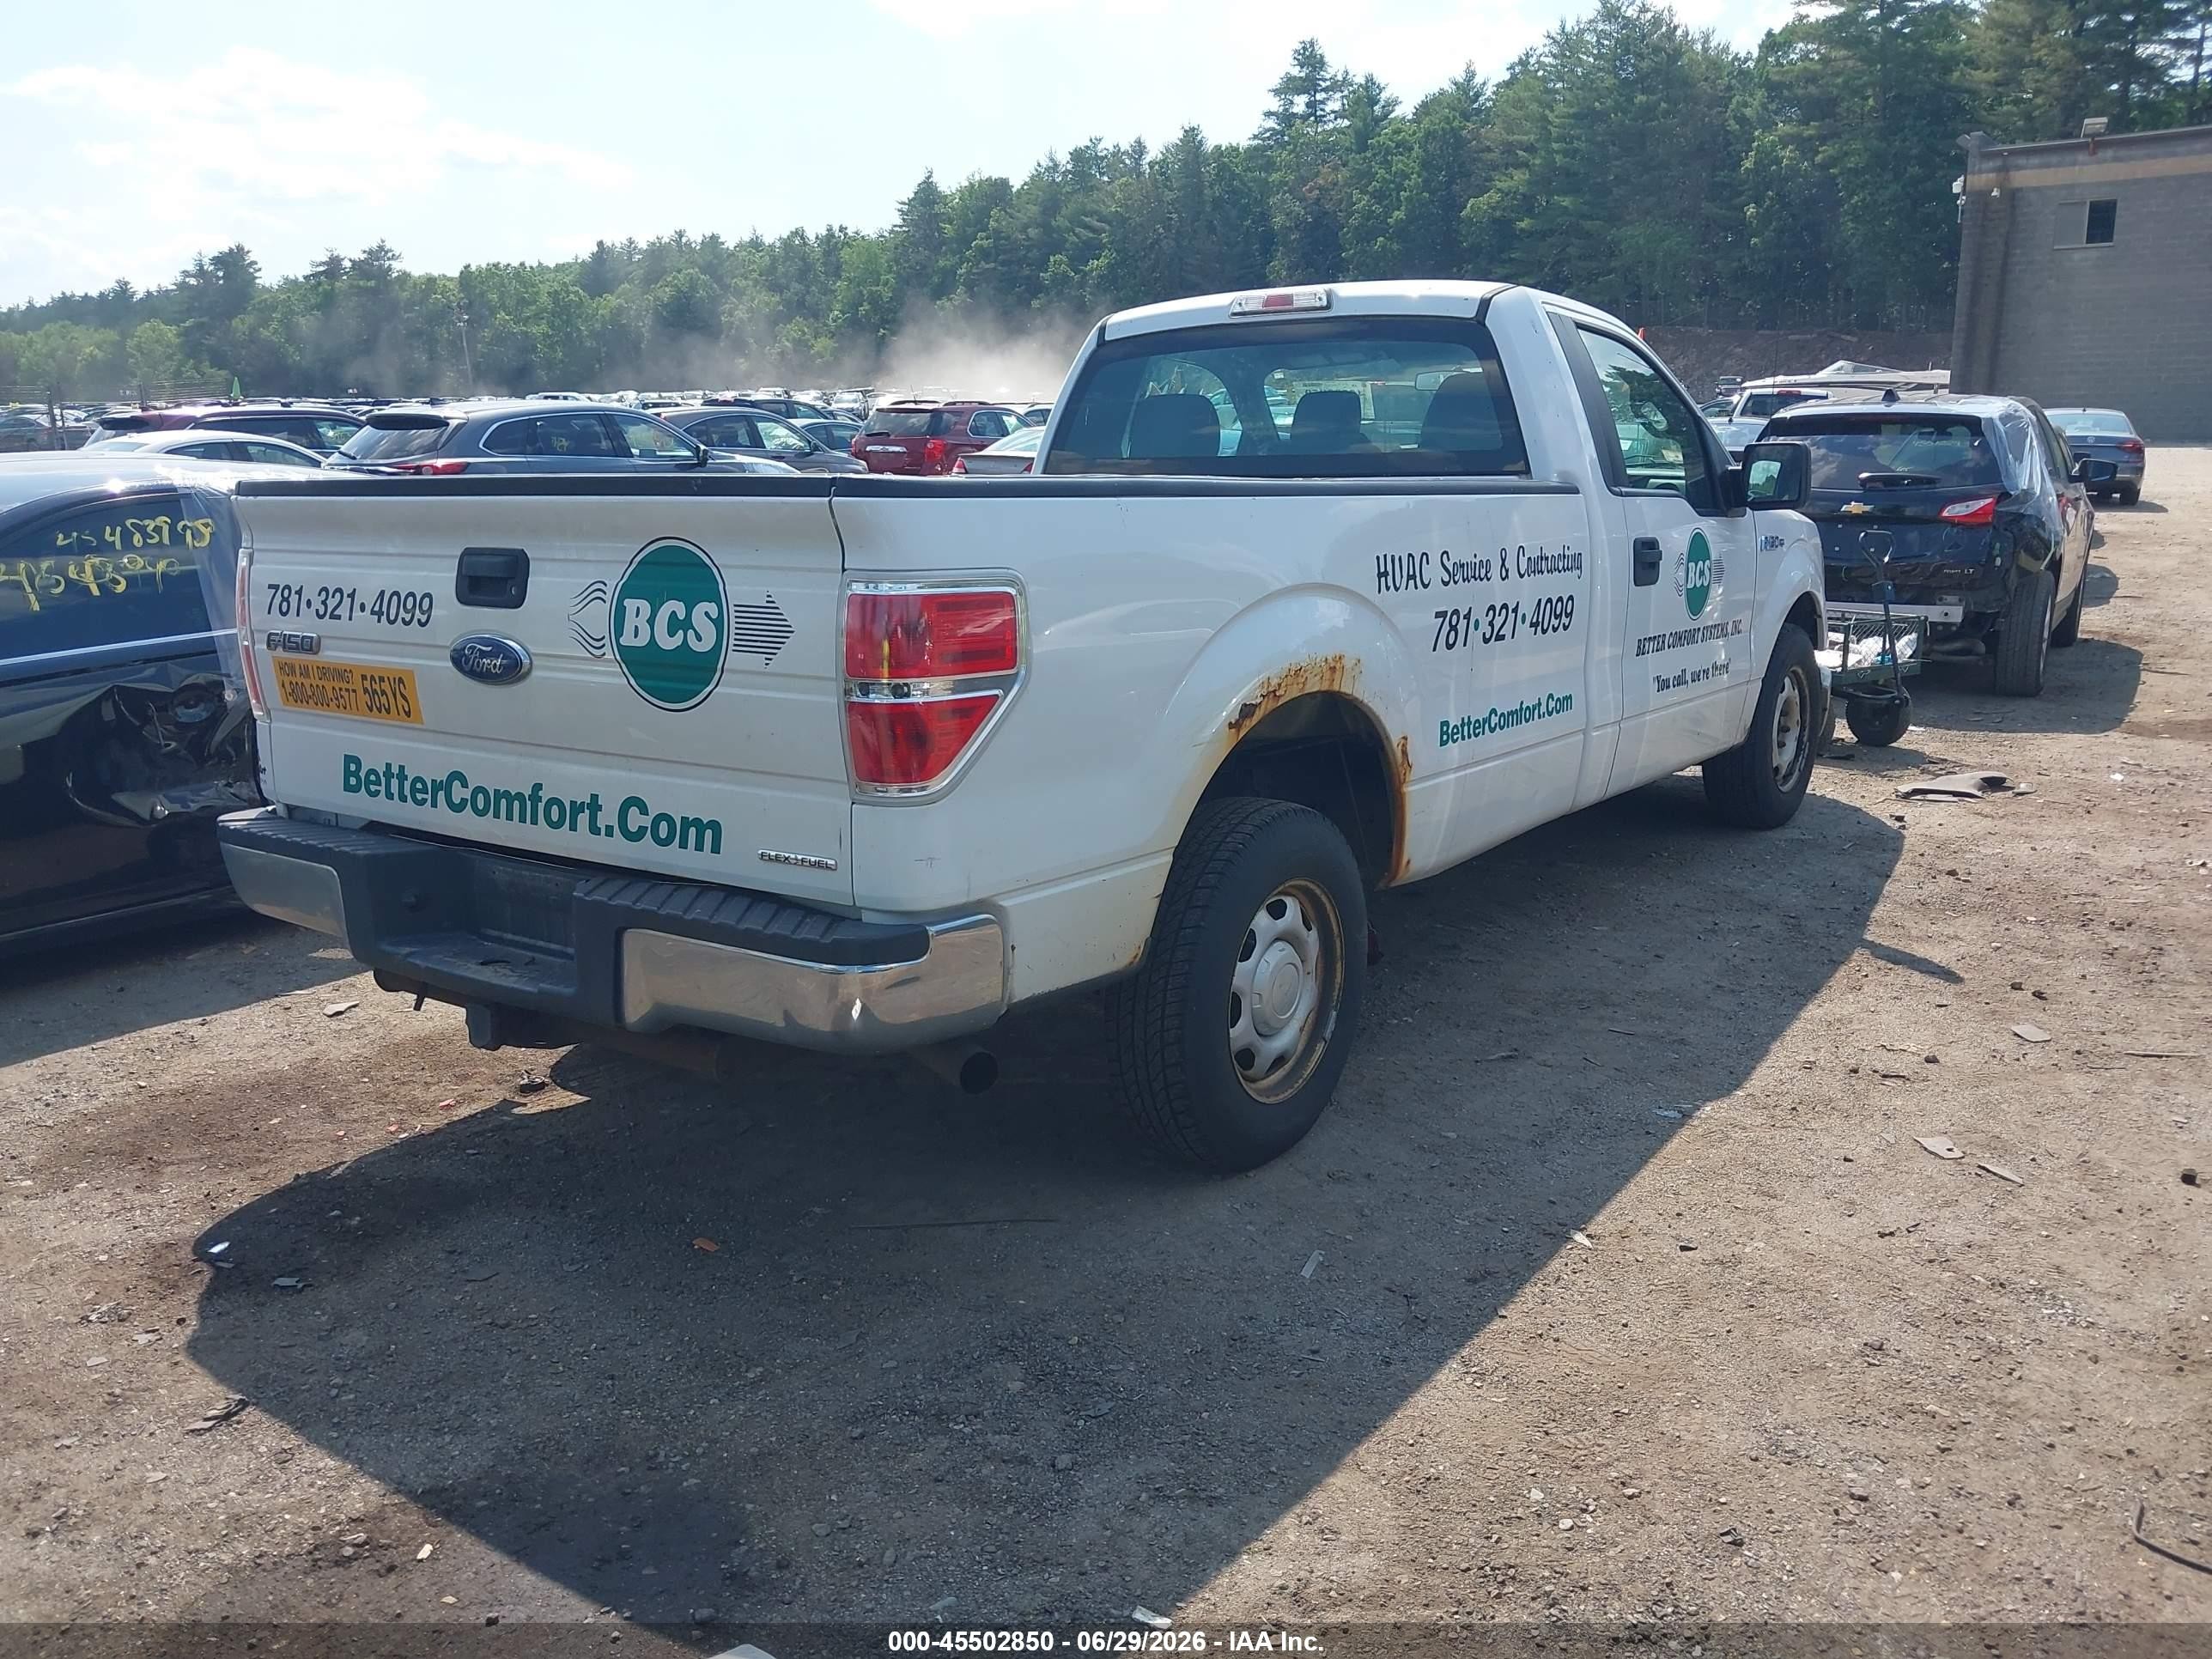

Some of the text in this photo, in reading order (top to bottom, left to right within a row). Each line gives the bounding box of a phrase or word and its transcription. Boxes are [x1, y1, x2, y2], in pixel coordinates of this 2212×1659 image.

[1440, 550, 1492, 587] Service
[1499, 547, 1510, 581] &
[1516, 544, 1583, 580] Contracting
[1686, 559, 1711, 589] BCS
[619, 598, 719, 653] BCS
[1635, 618, 1742, 658] BETTER COMFORT SYSTEMS, INC.
[278, 661, 355, 684] HOW AM I DRIVING?
[1672, 668, 1689, 690] call,
[1691, 665, 1711, 684] we're
[281, 679, 360, 712] 1-800-800-9577
[361, 673, 411, 719] 565YS
[1439, 692, 1573, 747] BetterComfort.Com
[343, 753, 723, 855] BetterComfort.Com
[760, 851, 836, 870] FLEX FUEL
